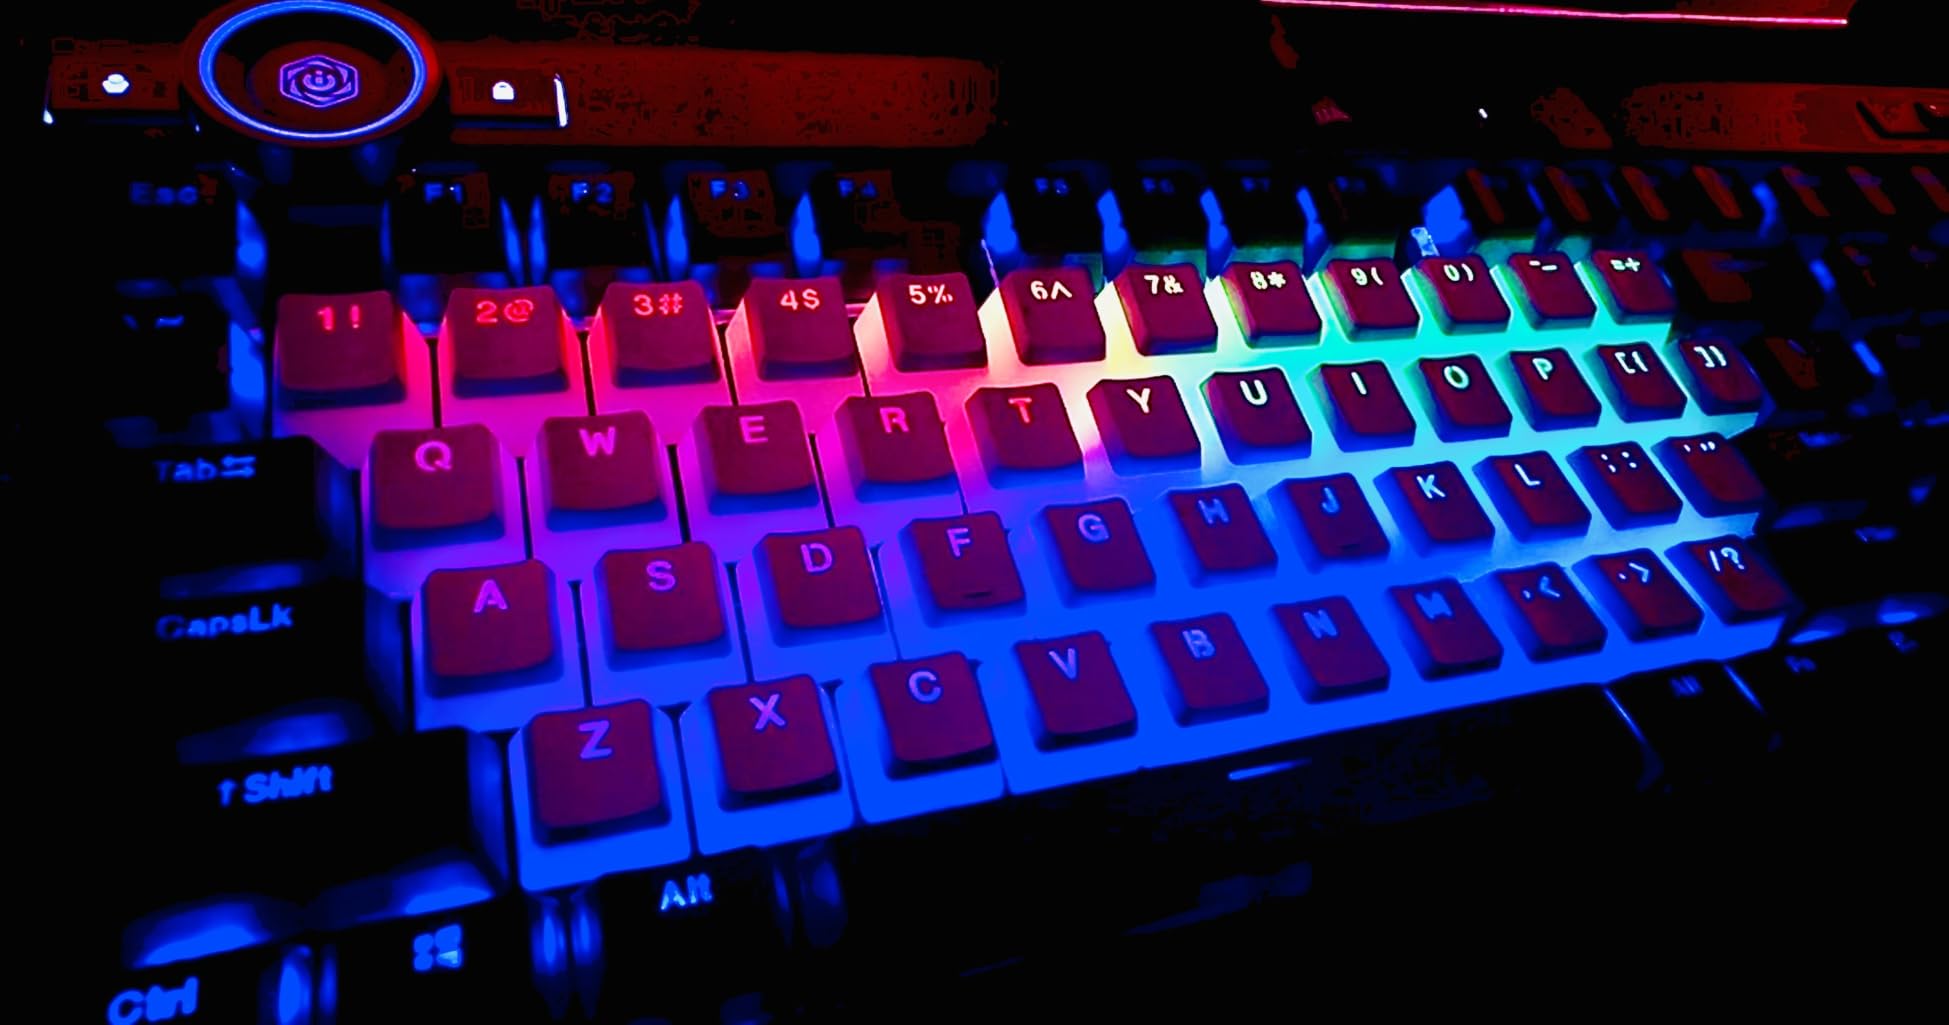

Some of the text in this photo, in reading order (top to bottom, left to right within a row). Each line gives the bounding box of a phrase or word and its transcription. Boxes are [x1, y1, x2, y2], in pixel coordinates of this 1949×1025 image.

[128, 181, 198, 206] Esc
[423, 181, 465, 203] F1
[569, 181, 614, 204] F2
[1443, 364, 1470, 390] O
[1532, 357, 1554, 381] P
[1125, 387, 1152, 415] Y
[1239, 379, 1268, 407] U
[880, 407, 909, 434] R
[1009, 398, 1032, 423] T
[578, 428, 617, 456] W
[738, 416, 769, 444] E
[155, 457, 215, 482] Tab
[414, 441, 452, 472] Q
[1416, 473, 1446, 499] K
[1513, 463, 1541, 487] L
[1198, 498, 1229, 525] H
[1322, 487, 1339, 514] J
[1078, 513, 1109, 541] G
[946, 527, 972, 556] F
[802, 542, 833, 573] D
[645, 561, 676, 590] S
[472, 580, 508, 613] A
[155, 602, 295, 641] CapsLk
[1303, 610, 1338, 640] N
[1182, 628, 1217, 659] B
[1048, 648, 1077, 680] V
[908, 671, 941, 702] C
[750, 694, 786, 730] X
[578, 720, 612, 759] Z
[242, 765, 333, 803] Shift
[661, 875, 713, 910] Alt
[108, 977, 199, 1025] Ctrl
